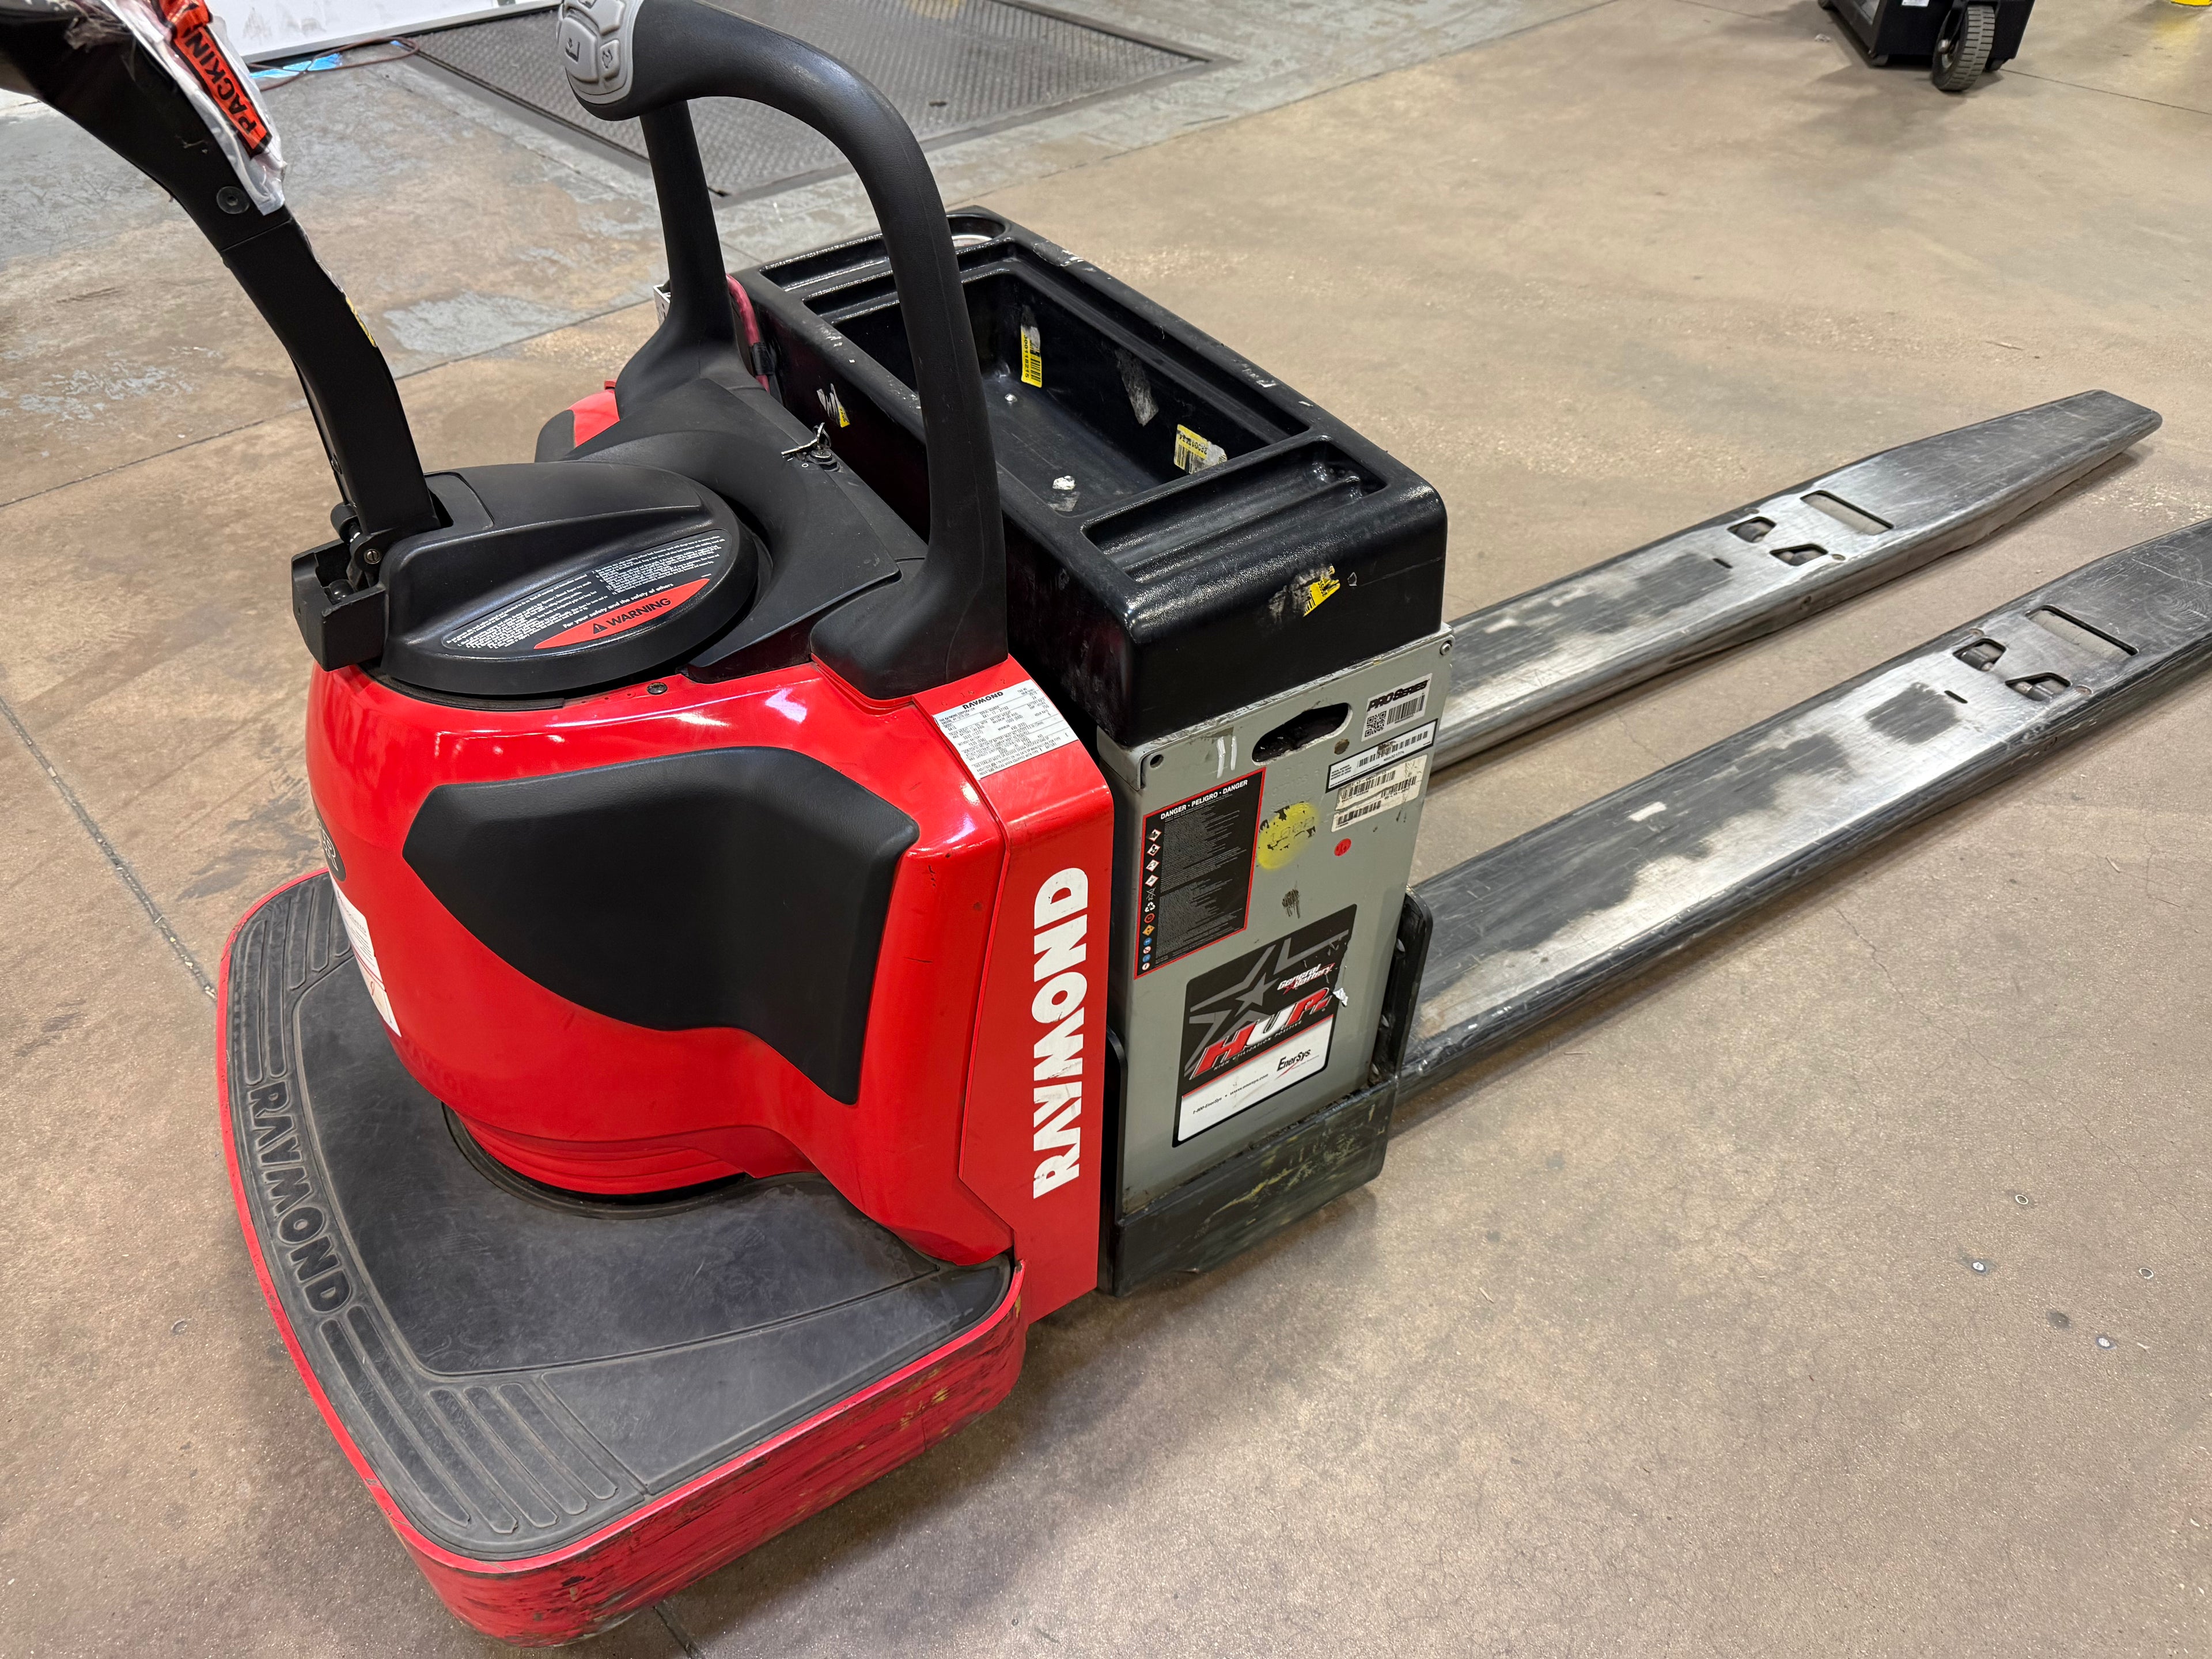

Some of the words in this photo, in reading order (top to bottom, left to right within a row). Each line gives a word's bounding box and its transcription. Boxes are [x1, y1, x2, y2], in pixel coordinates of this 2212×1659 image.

[574, 616, 588, 624] your
[589, 608, 607, 617] safety
[607, 597, 672, 627] WARNING
[962, 691, 1004, 710] RAYMOND
[1161, 805, 1187, 820] DANGER
[1191, 792, 1218, 807] PELIGRO
[1222, 779, 1248, 794] DANGER
[1277, 963, 1321, 990] General
[1031, 867, 1089, 1199] RAYMOND
[1277, 1049, 1310, 1071] EnerSys
[248, 1080, 353, 1313] RAYMOND
